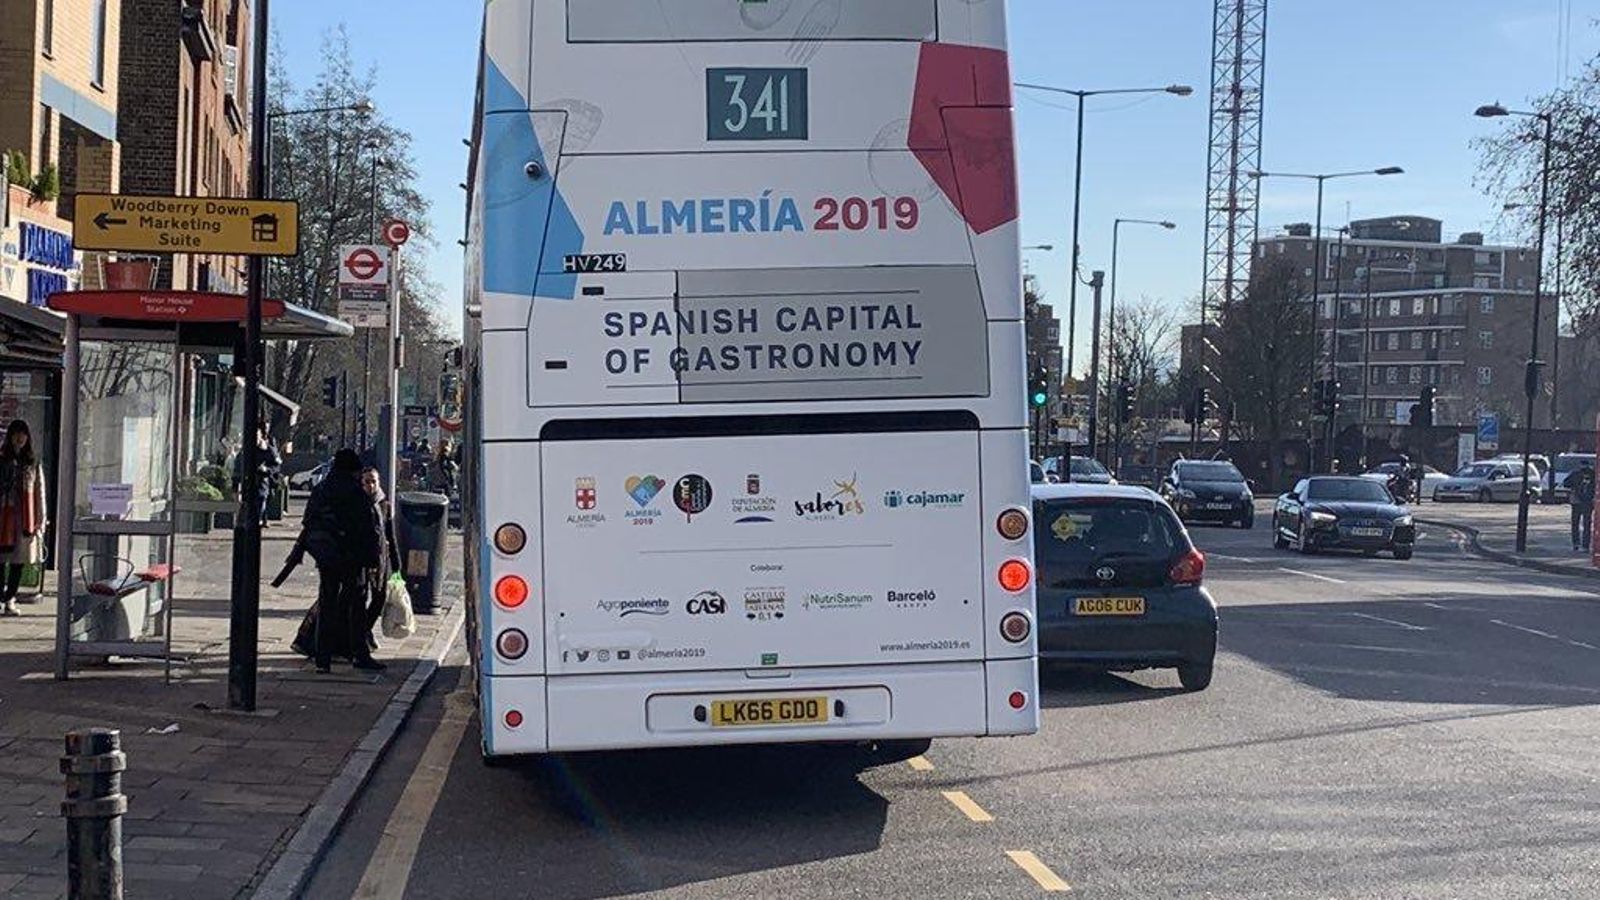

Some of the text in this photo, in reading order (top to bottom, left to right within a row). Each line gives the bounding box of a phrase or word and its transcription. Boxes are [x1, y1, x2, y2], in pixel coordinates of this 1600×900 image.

[724, 75, 789, 132] 341
[110, 198, 250, 216] Woodberry Down
[603, 189, 920, 235] ALMERÍA 2019
[139, 216, 222, 233] Marketing
[158, 233, 201, 247] Suite
[563, 254, 626, 271] HV249
[603, 304, 923, 338] SPANISH CAPITAL
[605, 340, 923, 375] OF GASTRONOMY
[906, 491, 965, 507] cajamar
[887, 590, 937, 602] Barceló
[686, 597, 726, 615] CASI
[1078, 599, 1142, 613] AG06 CUK
[720, 700, 819, 722] LK66 GDO
